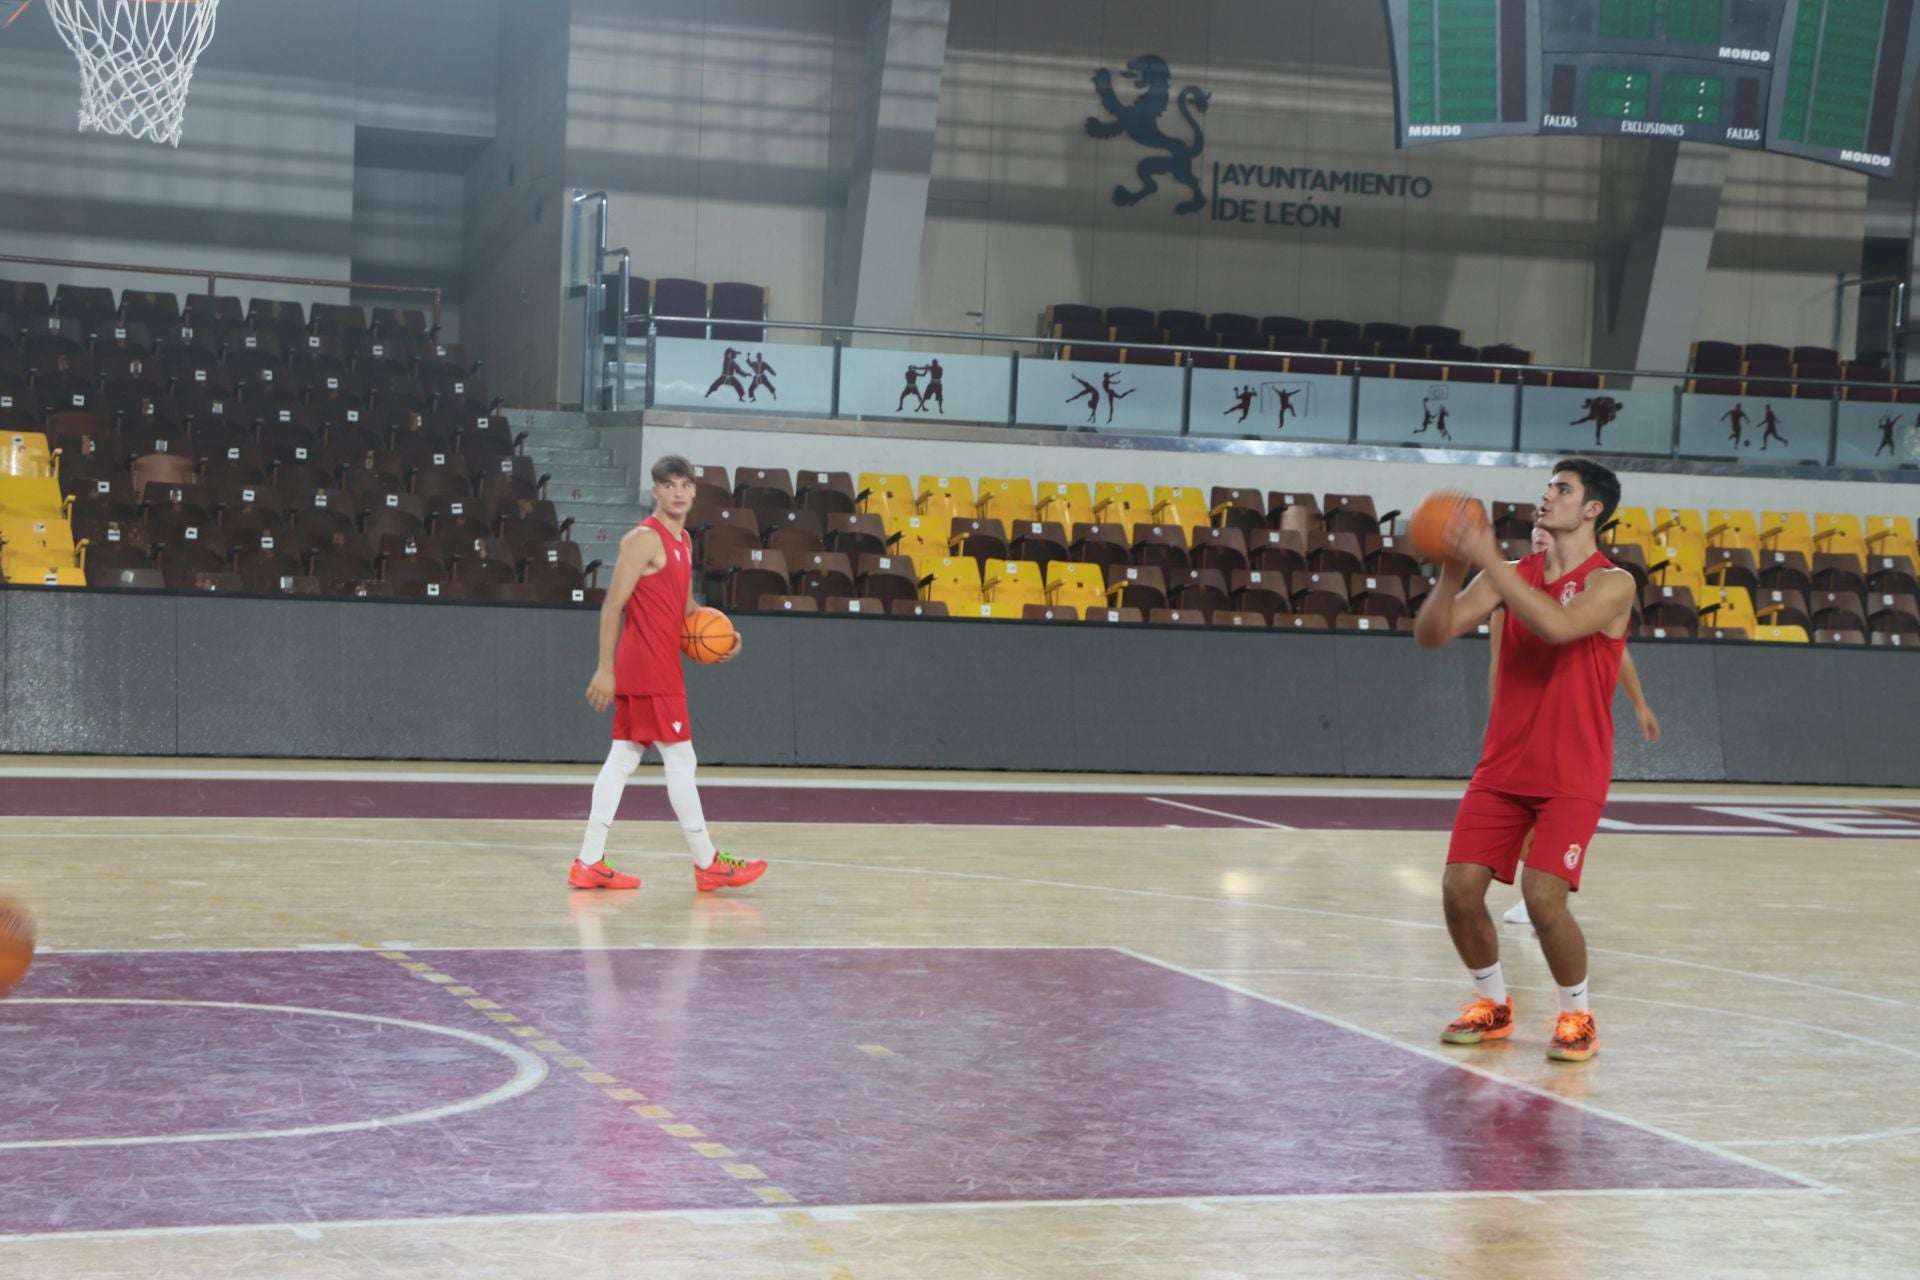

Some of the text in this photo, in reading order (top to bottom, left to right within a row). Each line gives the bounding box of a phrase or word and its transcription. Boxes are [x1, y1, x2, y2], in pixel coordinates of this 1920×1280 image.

[1718, 47, 1771, 62] MONDO
[1544, 115, 1578, 128] FALTAS
[1621, 120, 1685, 136] EXCLUSIONES
[1409, 125, 1461, 137] MONDO
[1726, 128, 1761, 141] FALTAS
[1840, 150, 1892, 167] MONDO
[1221, 163, 1432, 199] AYUNTAMIENTO
[1219, 196, 1342, 228] DE LEÓN
